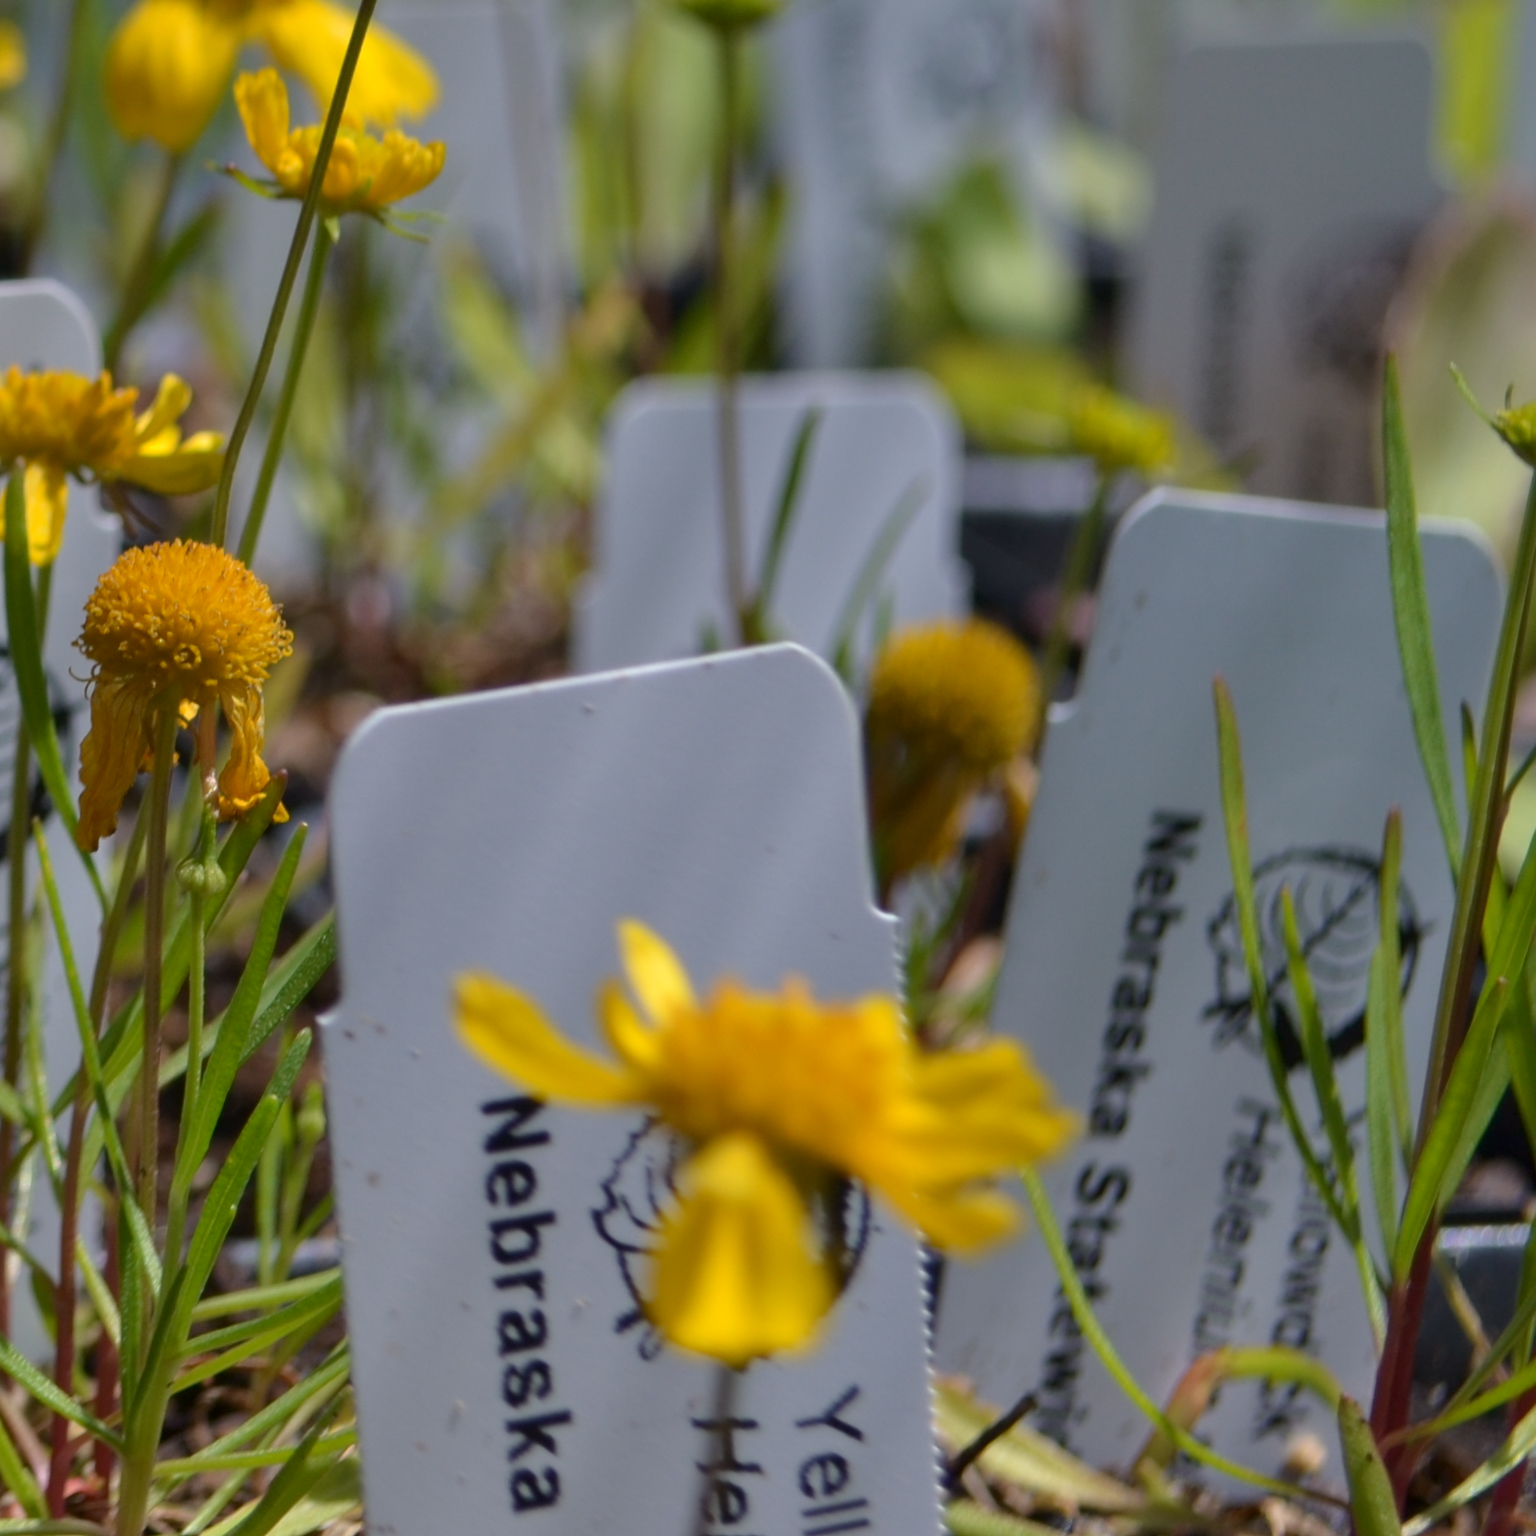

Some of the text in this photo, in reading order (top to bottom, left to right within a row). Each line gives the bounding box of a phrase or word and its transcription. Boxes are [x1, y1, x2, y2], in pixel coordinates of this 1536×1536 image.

[1085, 811, 1203, 1140] Nebraska
[479, 1096, 572, 1513] Nebraska
[1192, 1097, 1280, 1409] Heleniu
[689, 1417, 764, 1535] He
